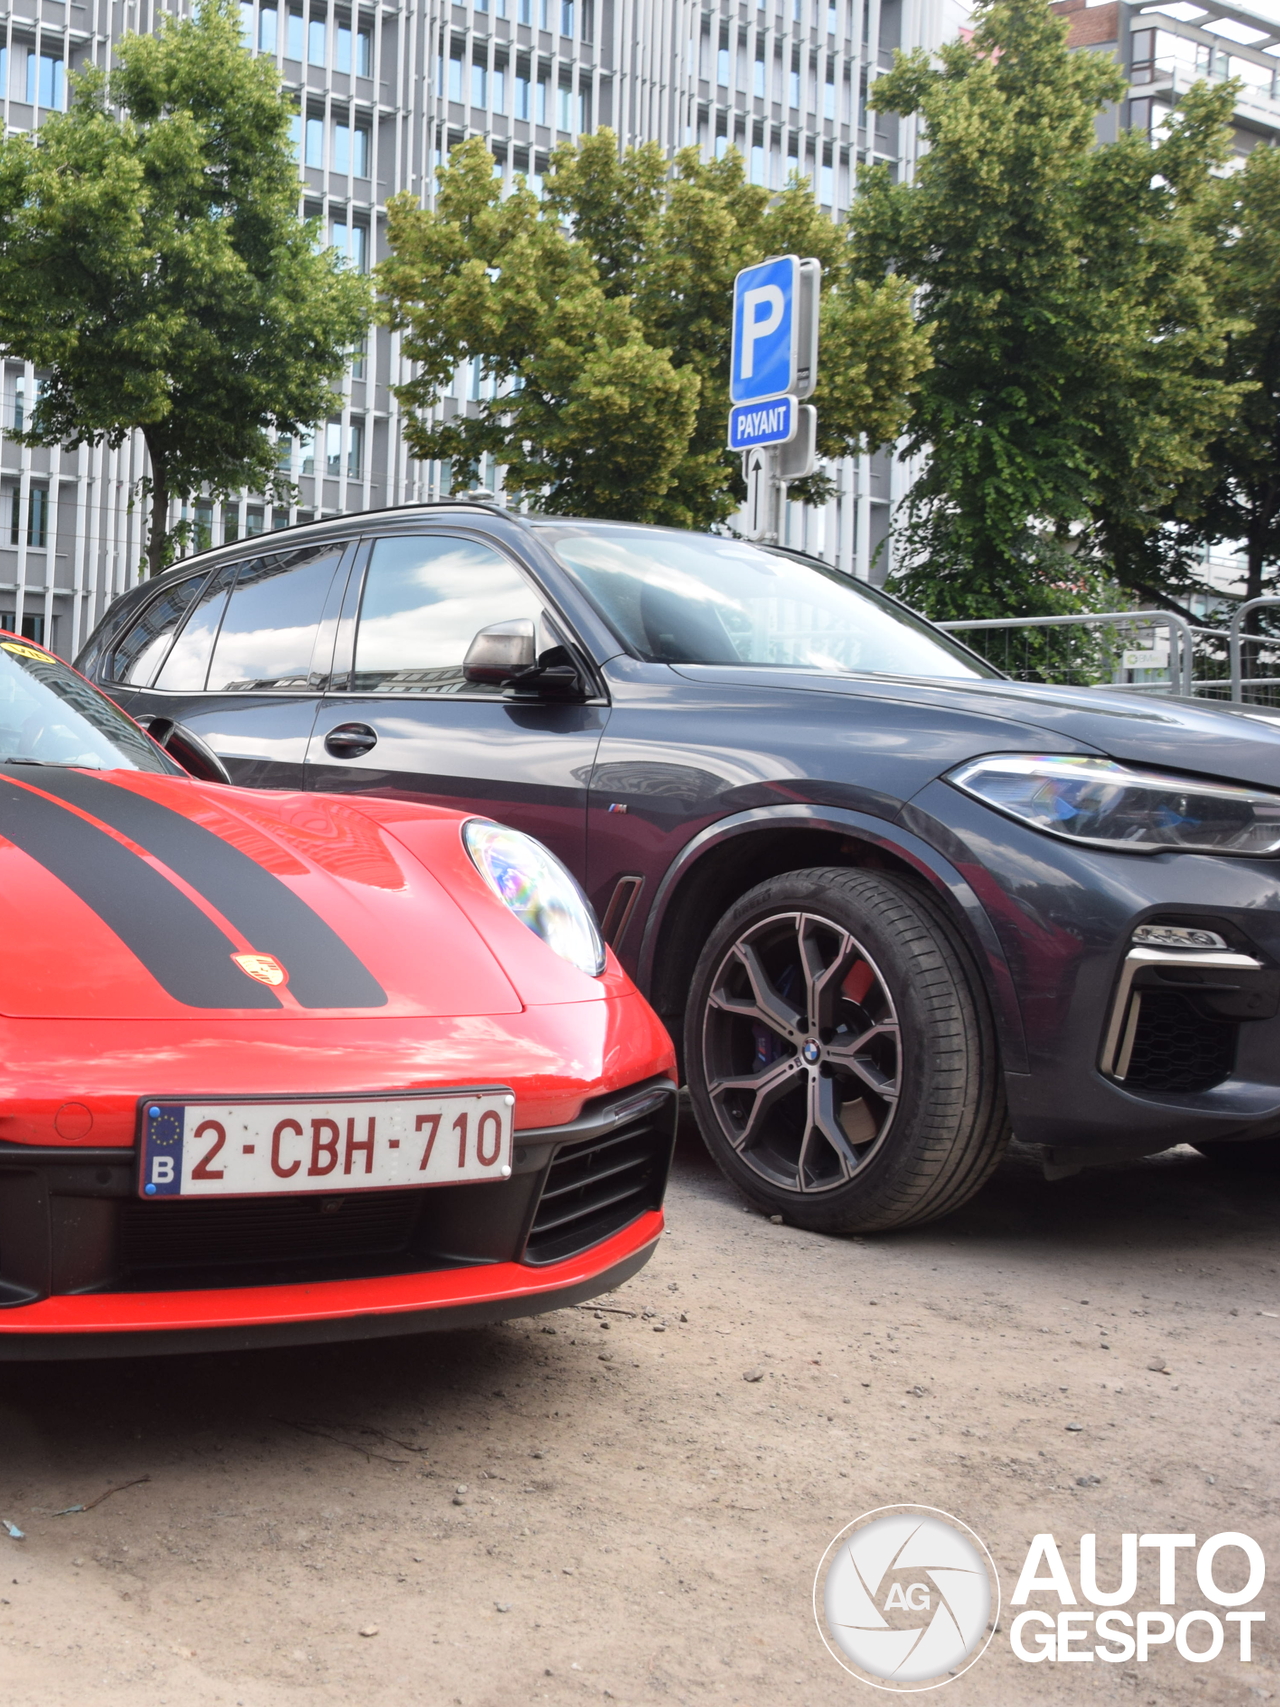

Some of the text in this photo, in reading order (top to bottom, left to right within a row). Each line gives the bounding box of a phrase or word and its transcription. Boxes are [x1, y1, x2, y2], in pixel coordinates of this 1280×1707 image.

[740, 284, 785, 380] P
[736, 405, 787, 440] PAYANT
[151, 1156, 174, 1184] B
[191, 1109, 502, 1180] 2-CBH-710
